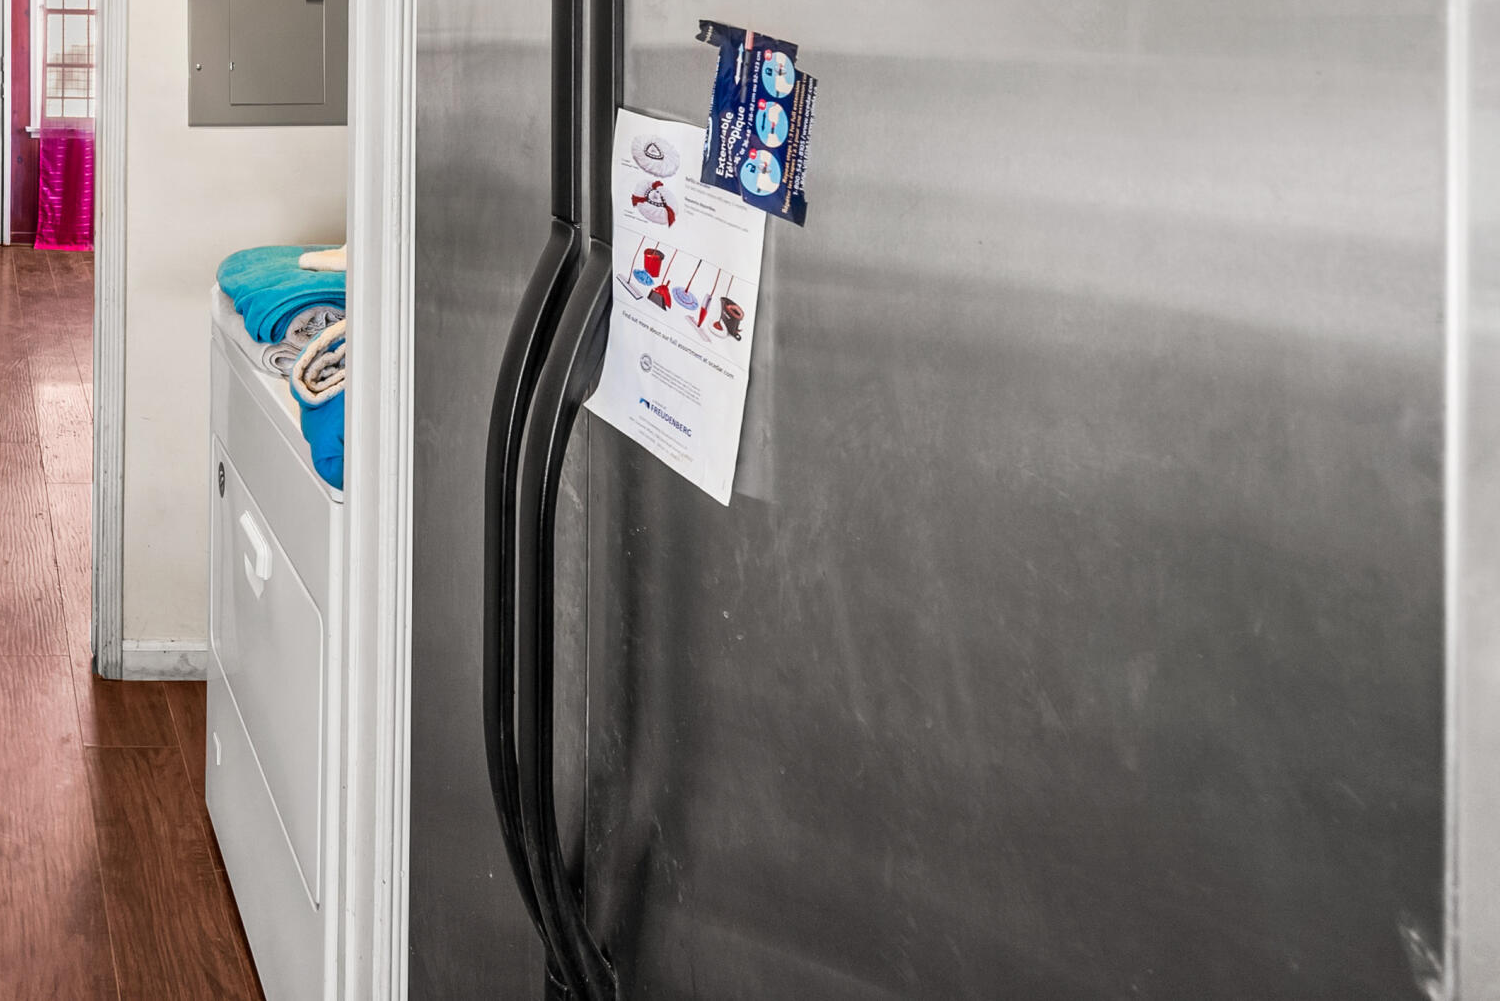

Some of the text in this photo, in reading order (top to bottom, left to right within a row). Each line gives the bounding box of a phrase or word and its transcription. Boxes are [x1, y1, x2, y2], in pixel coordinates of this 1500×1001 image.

[802, 77, 813, 136] www.ocedar.com
[716, 112, 734, 176] Extendable
[650, 404, 692, 437] FREUDENBERG
